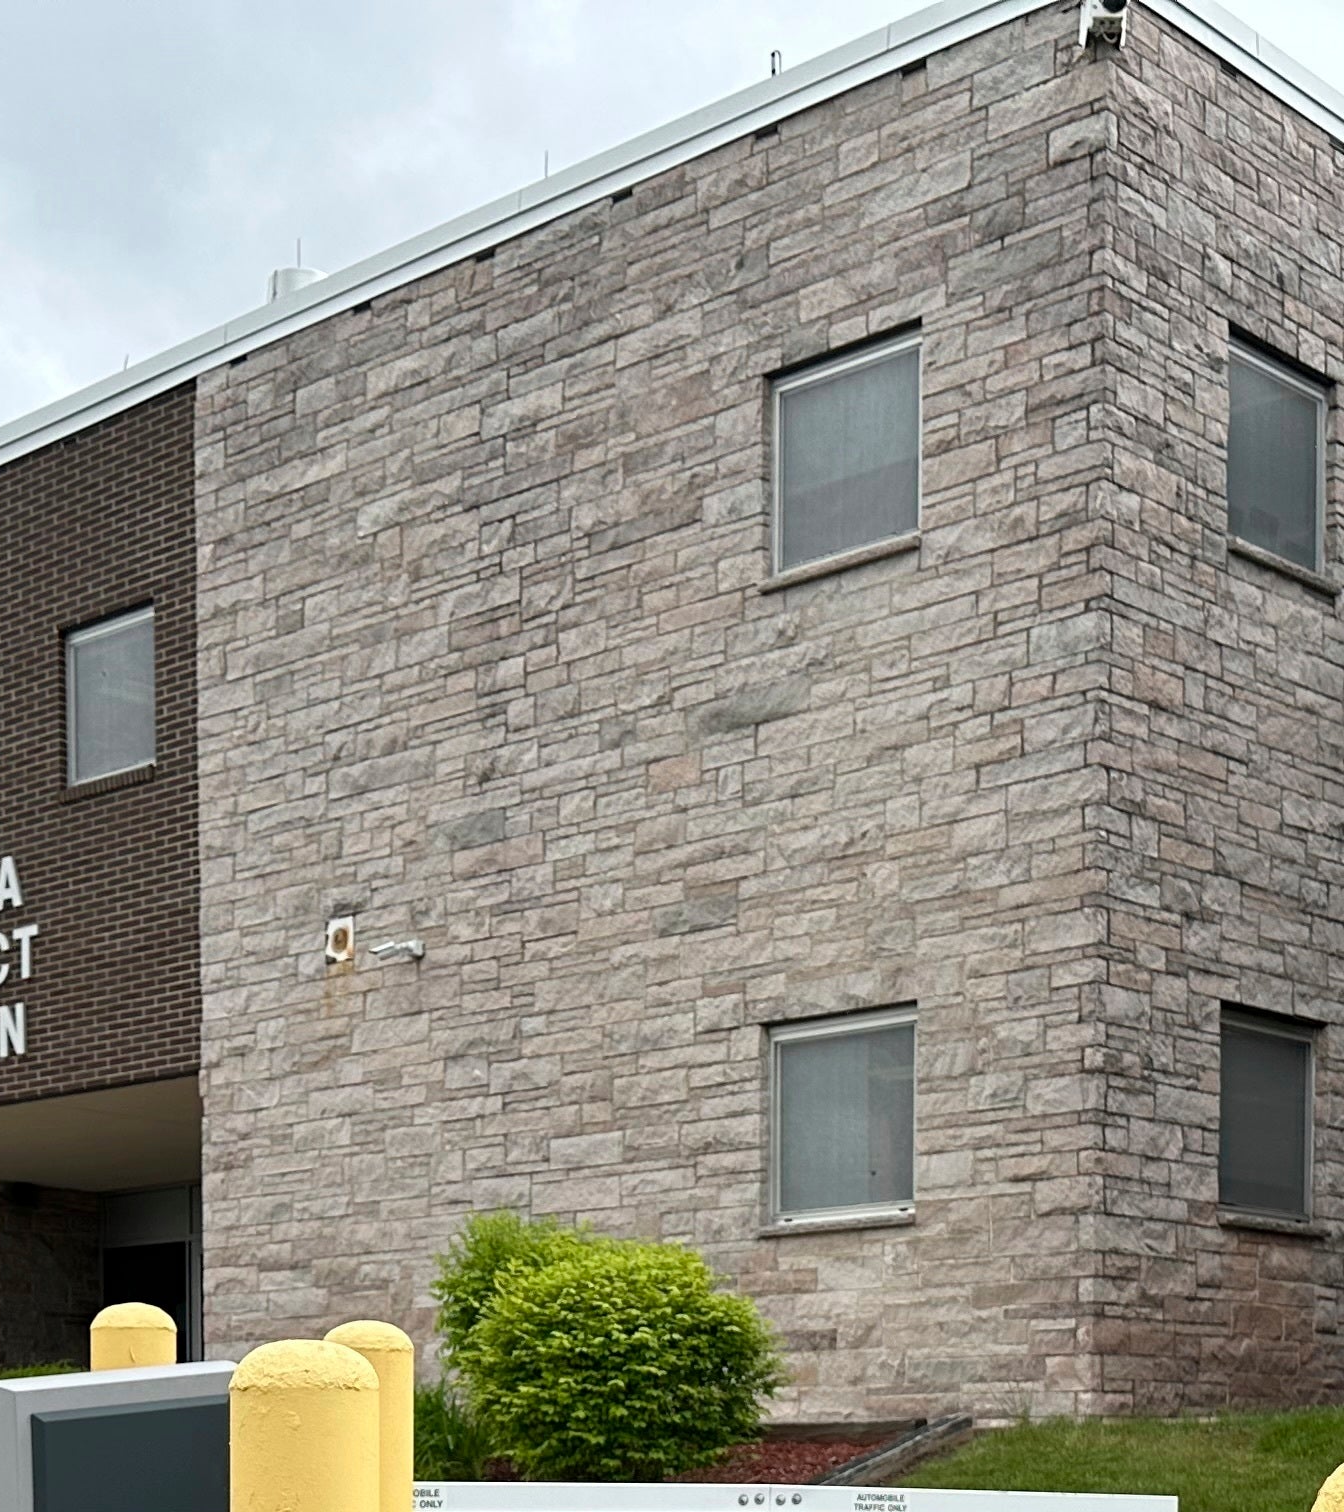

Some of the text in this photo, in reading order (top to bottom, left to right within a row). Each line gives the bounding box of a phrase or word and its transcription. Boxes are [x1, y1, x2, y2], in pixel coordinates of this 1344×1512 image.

[856, 1493, 905, 1502] AUTOMOBILE
[419, 1500, 443, 1508] ONLY
[854, 1503, 907, 1512] TRAFFIC ONLY
